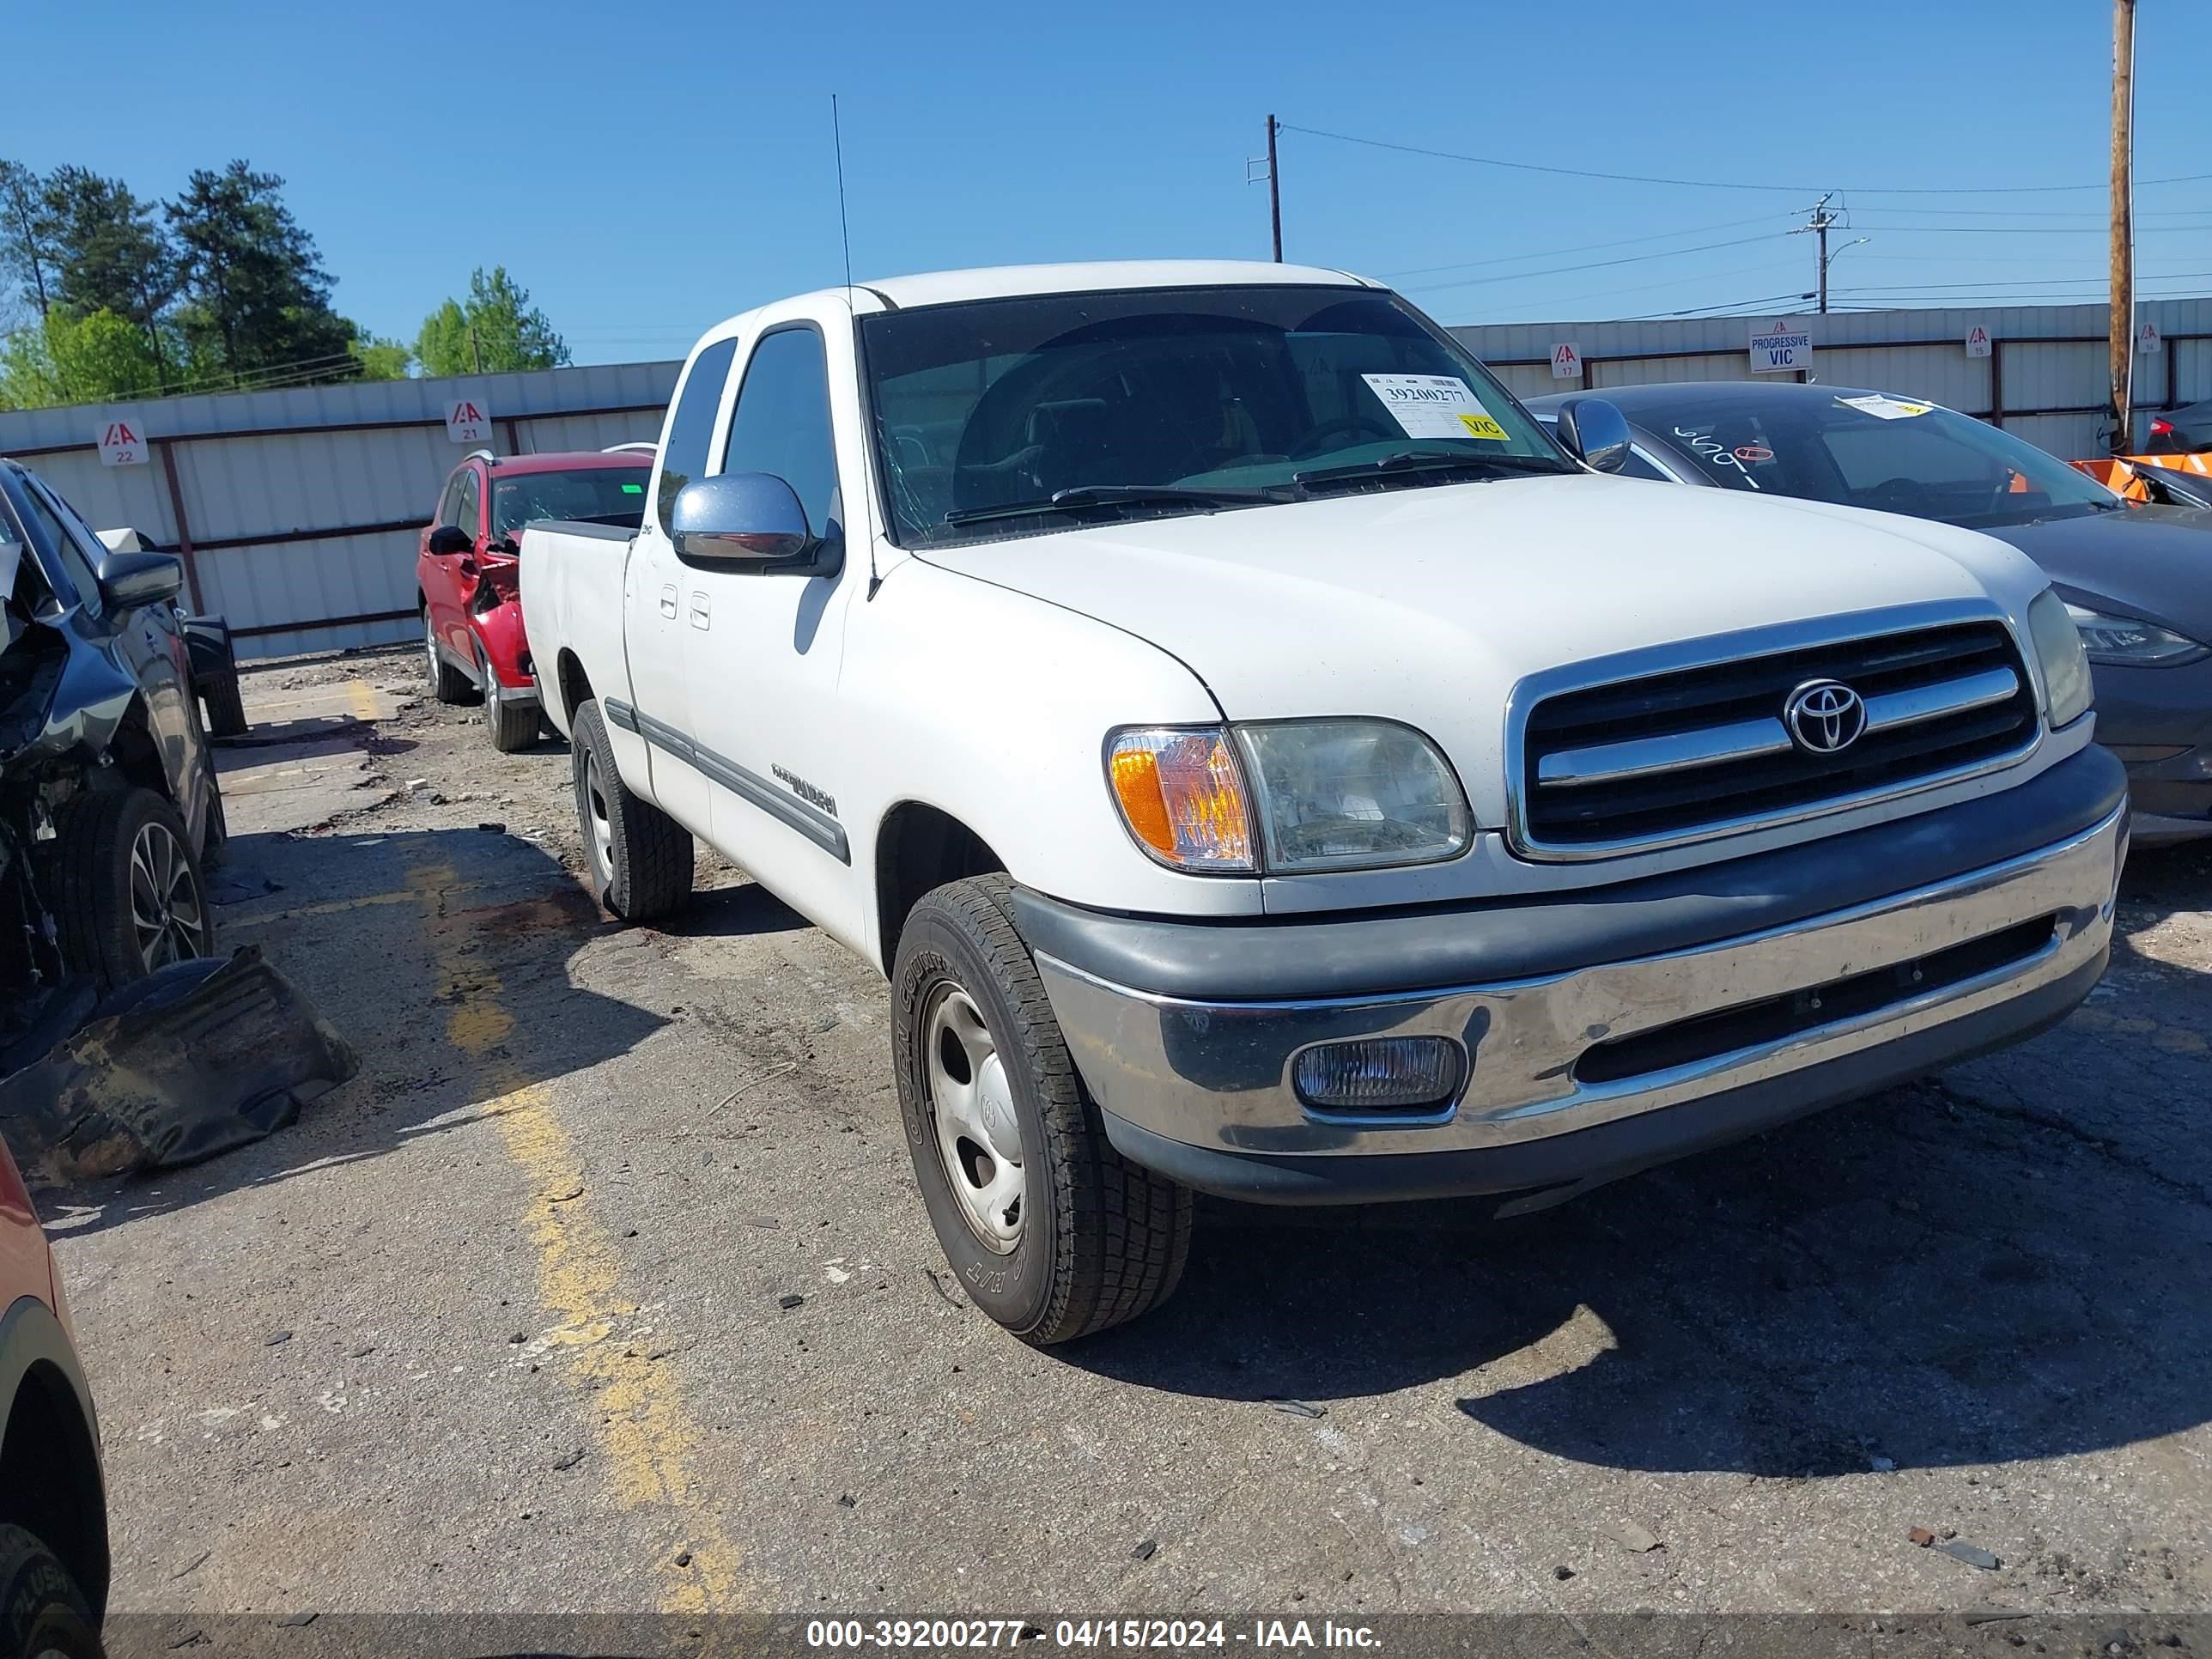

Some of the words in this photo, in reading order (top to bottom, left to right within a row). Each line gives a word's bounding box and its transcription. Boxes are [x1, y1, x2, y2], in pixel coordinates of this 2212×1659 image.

[1752, 335, 1808, 350] PROGRESSIVE
[1770, 349, 1793, 365] VIC
[1563, 368, 1572, 376] 17
[1385, 388, 1466, 403] 39200277
[1463, 420, 1499, 434] VIC
[463, 429, 477, 440] 21
[117, 452, 134, 463] 22
